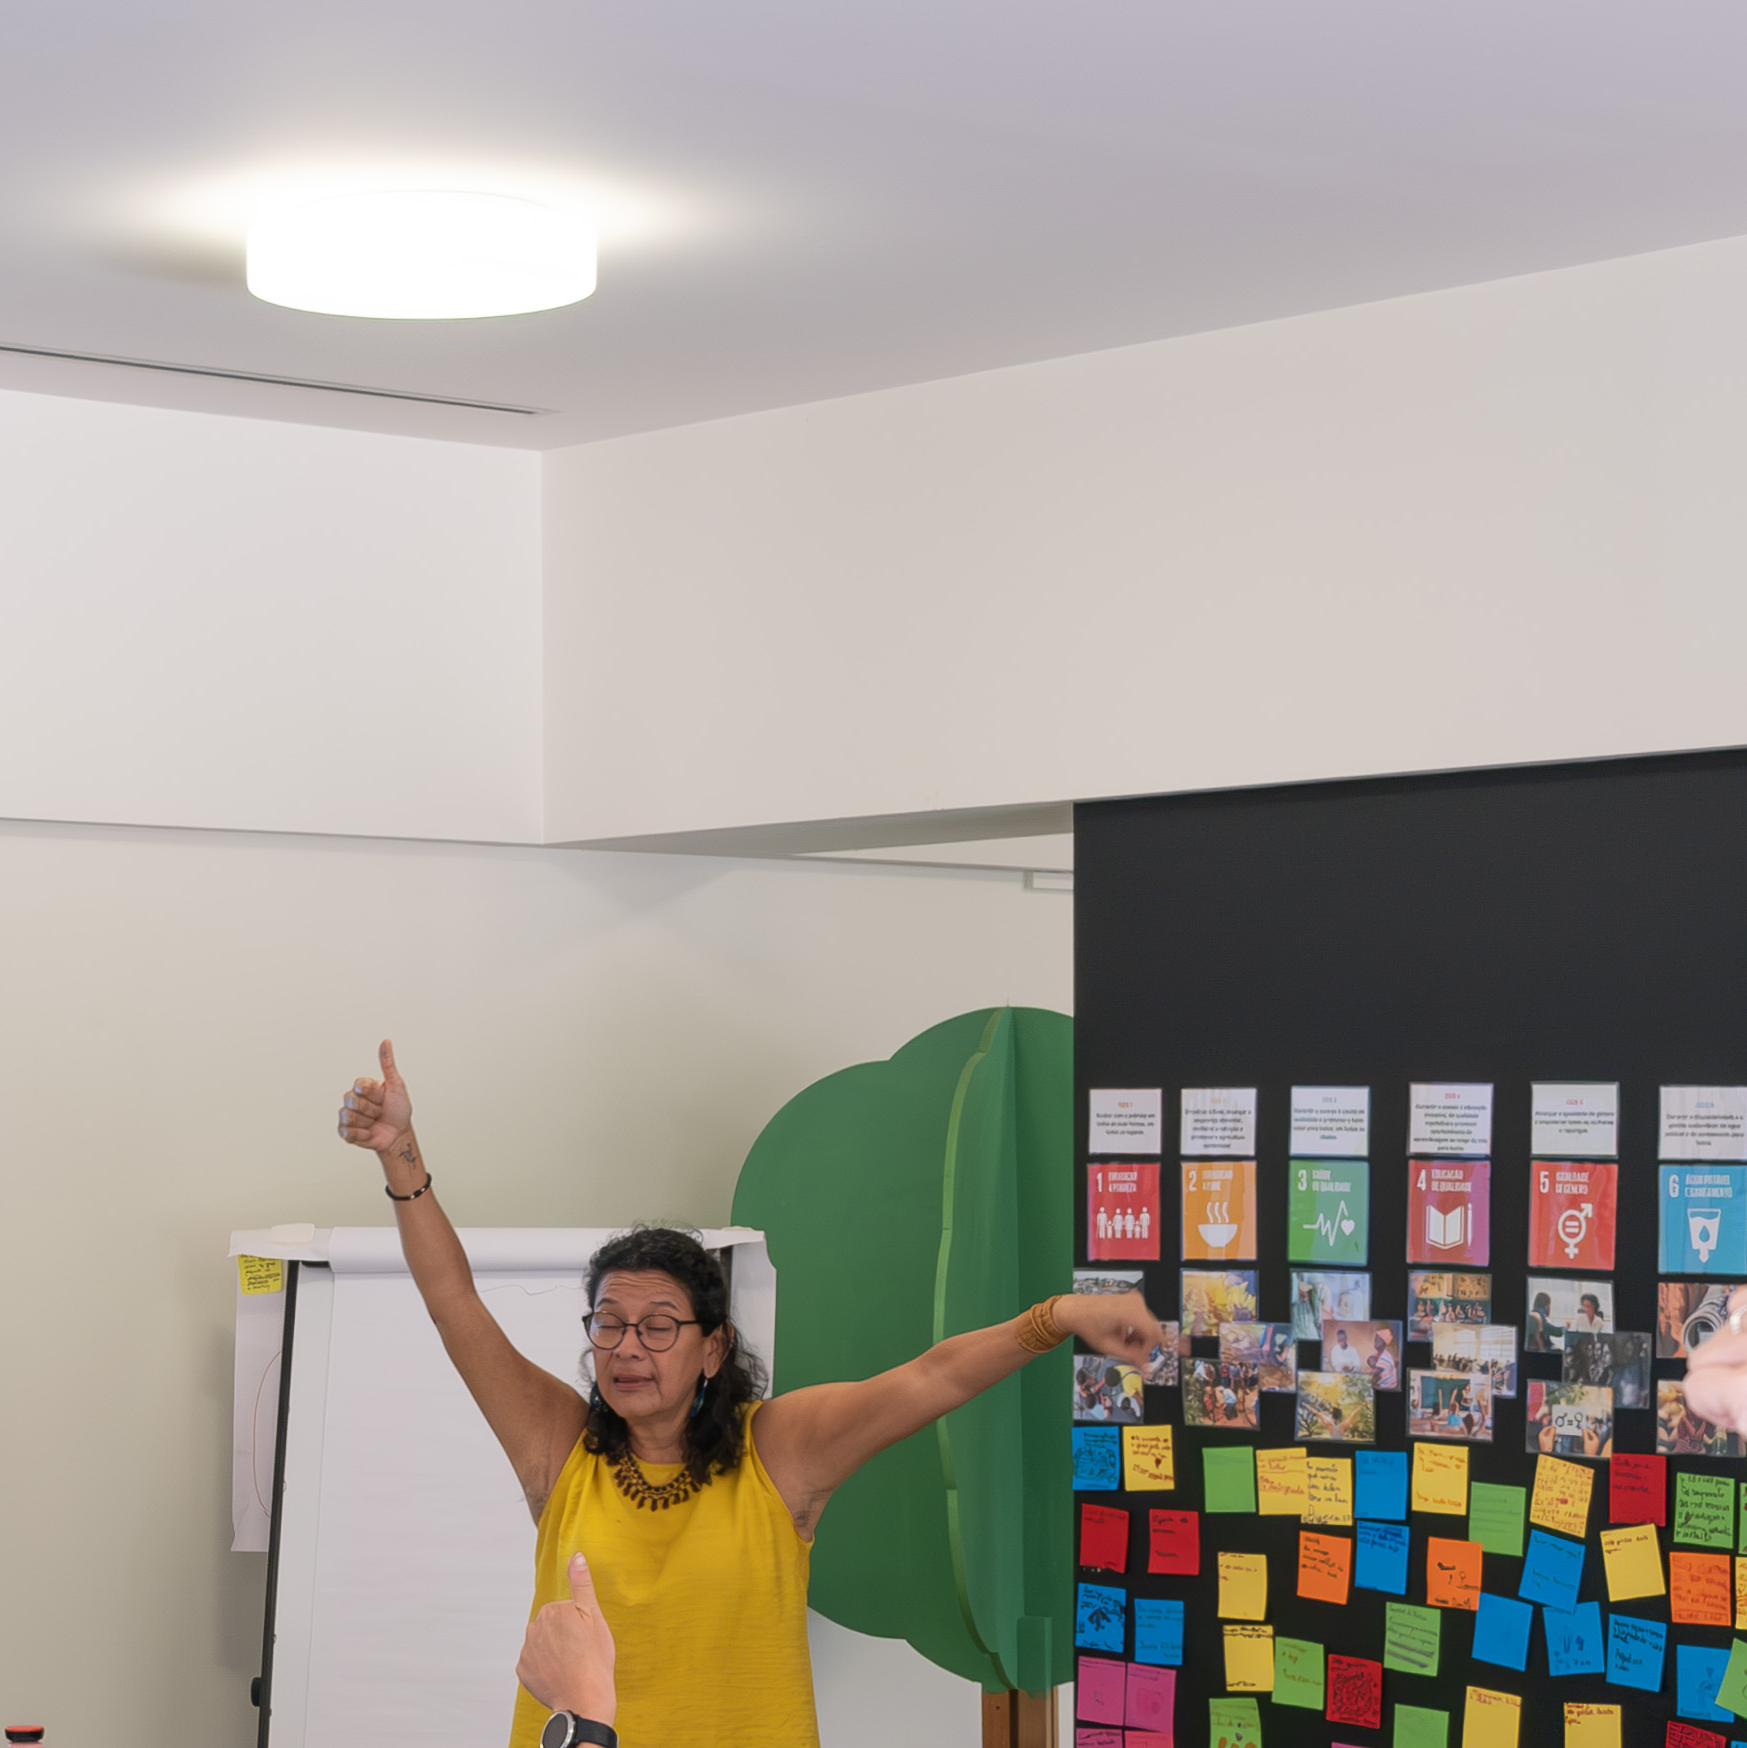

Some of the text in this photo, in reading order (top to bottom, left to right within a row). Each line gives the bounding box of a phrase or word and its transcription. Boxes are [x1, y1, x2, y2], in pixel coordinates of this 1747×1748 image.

[1096, 1172, 1103, 1192] 1
[1188, 1171, 1197, 1191] 2
[1297, 1169, 1307, 1191] 3
[1416, 1169, 1427, 1191] 4
[1539, 1171, 1550, 1193] 5
[1668, 1174, 1680, 1198] 6
